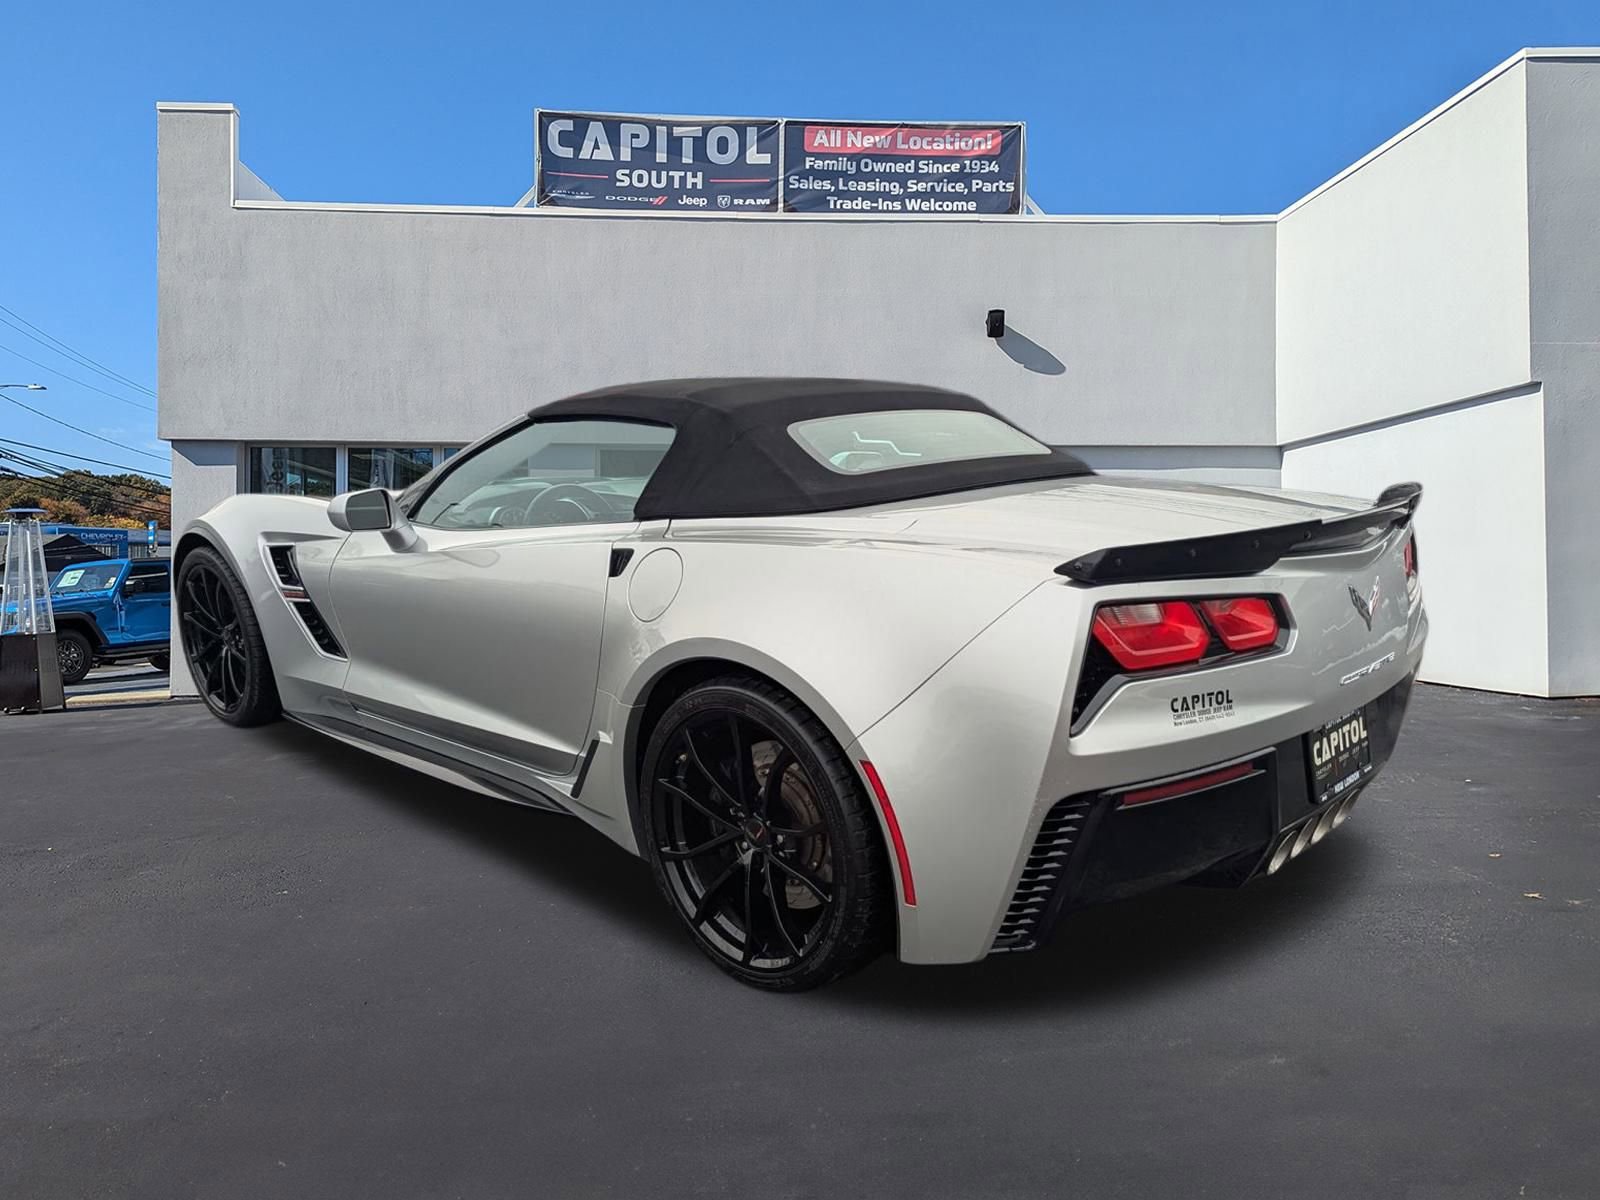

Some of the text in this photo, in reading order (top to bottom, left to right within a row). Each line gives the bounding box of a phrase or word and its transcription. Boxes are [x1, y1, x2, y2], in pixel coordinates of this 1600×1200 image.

[547, 119, 771, 165] CAPITOL
[813, 130, 993, 151] All New Location!
[804, 156, 1000, 174] Family Owned Since 1934
[615, 168, 703, 190] SOUTH
[789, 175, 1015, 195] Sales, Leasing, Service, Parts
[605, 195, 657, 203] DODGE
[678, 195, 708, 207] Jeep
[733, 198, 771, 206] RAM
[826, 196, 977, 212] Trade-Ins Welcome
[80, 532, 124, 541] CHEVROLET
[1170, 689, 1233, 713] CAPITOL
[1313, 716, 1367, 766] CAPITOL
